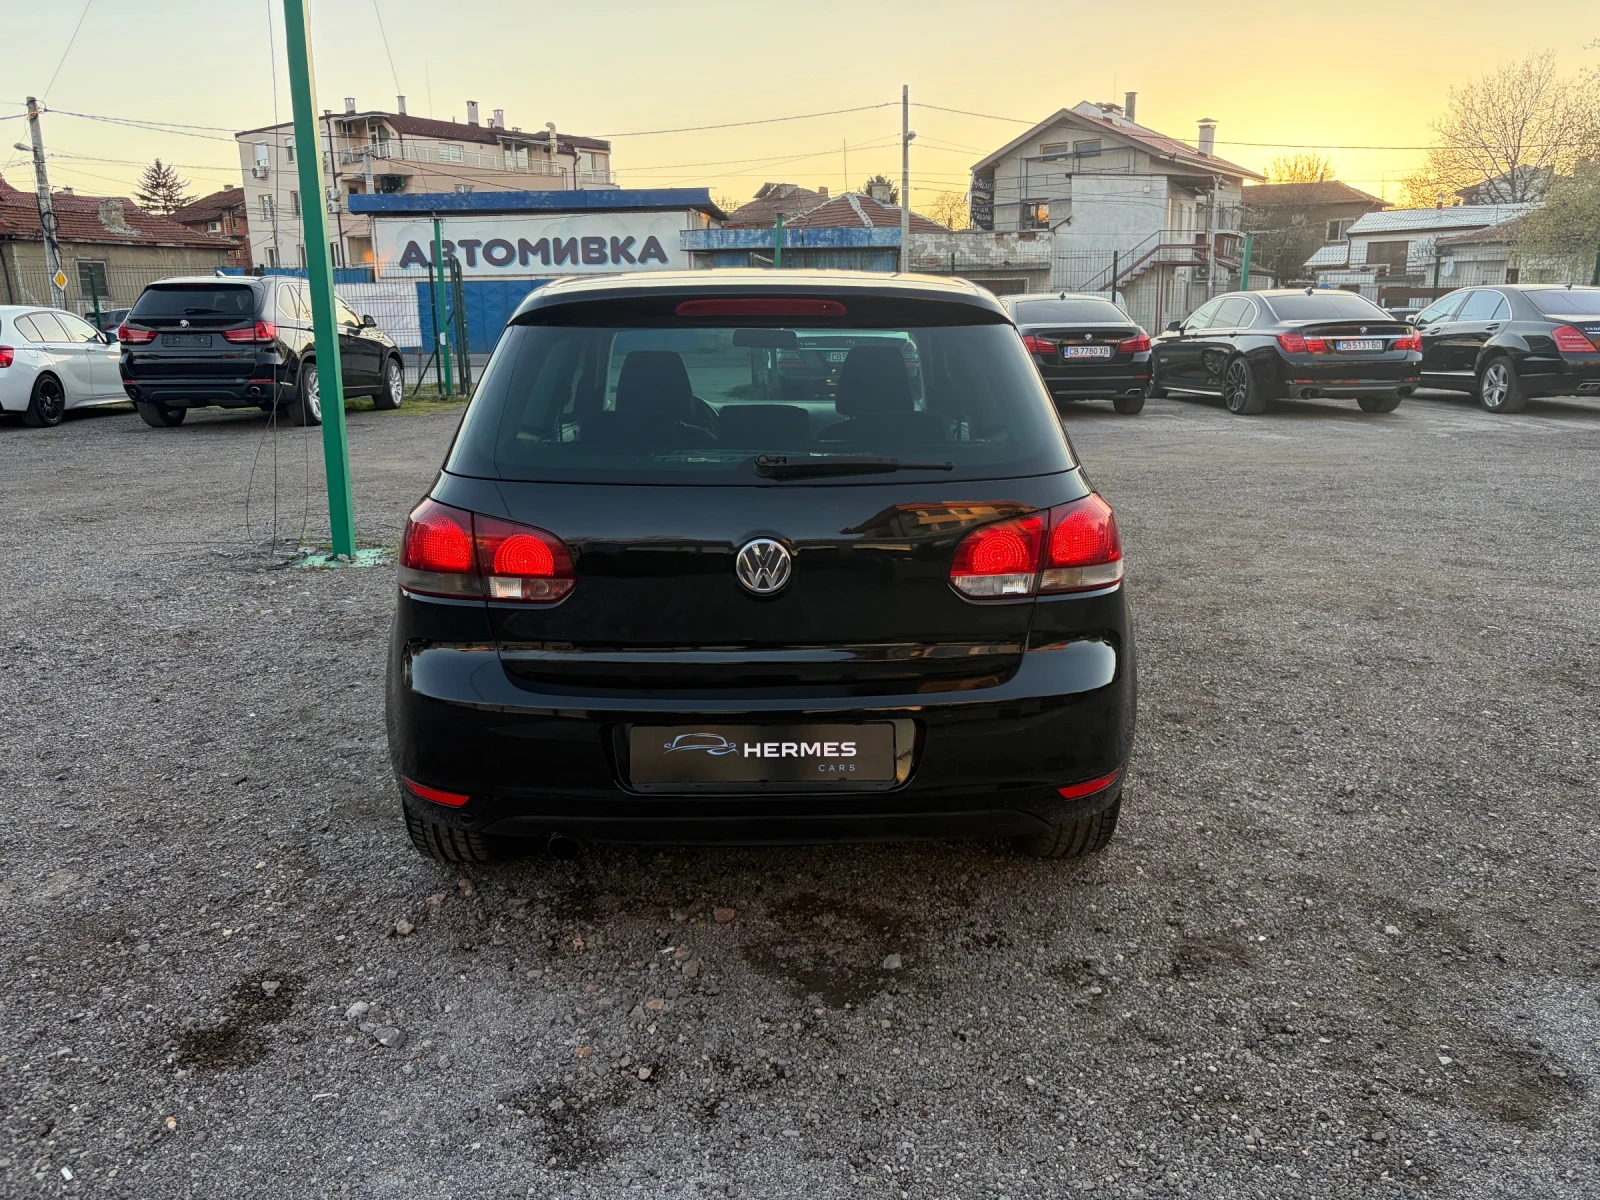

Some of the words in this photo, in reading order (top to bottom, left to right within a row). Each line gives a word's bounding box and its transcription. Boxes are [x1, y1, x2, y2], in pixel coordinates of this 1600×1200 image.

[399, 235, 669, 268] АВТОМИВКА
[1341, 341, 1351, 349] CB
[1352, 341, 1370, 349] 5131
[1069, 347, 1079, 355] CB
[1080, 347, 1098, 355] 7780
[1099, 347, 1109, 355] XB
[743, 742, 857, 758] HERMES
[818, 764, 856, 772] CARS
